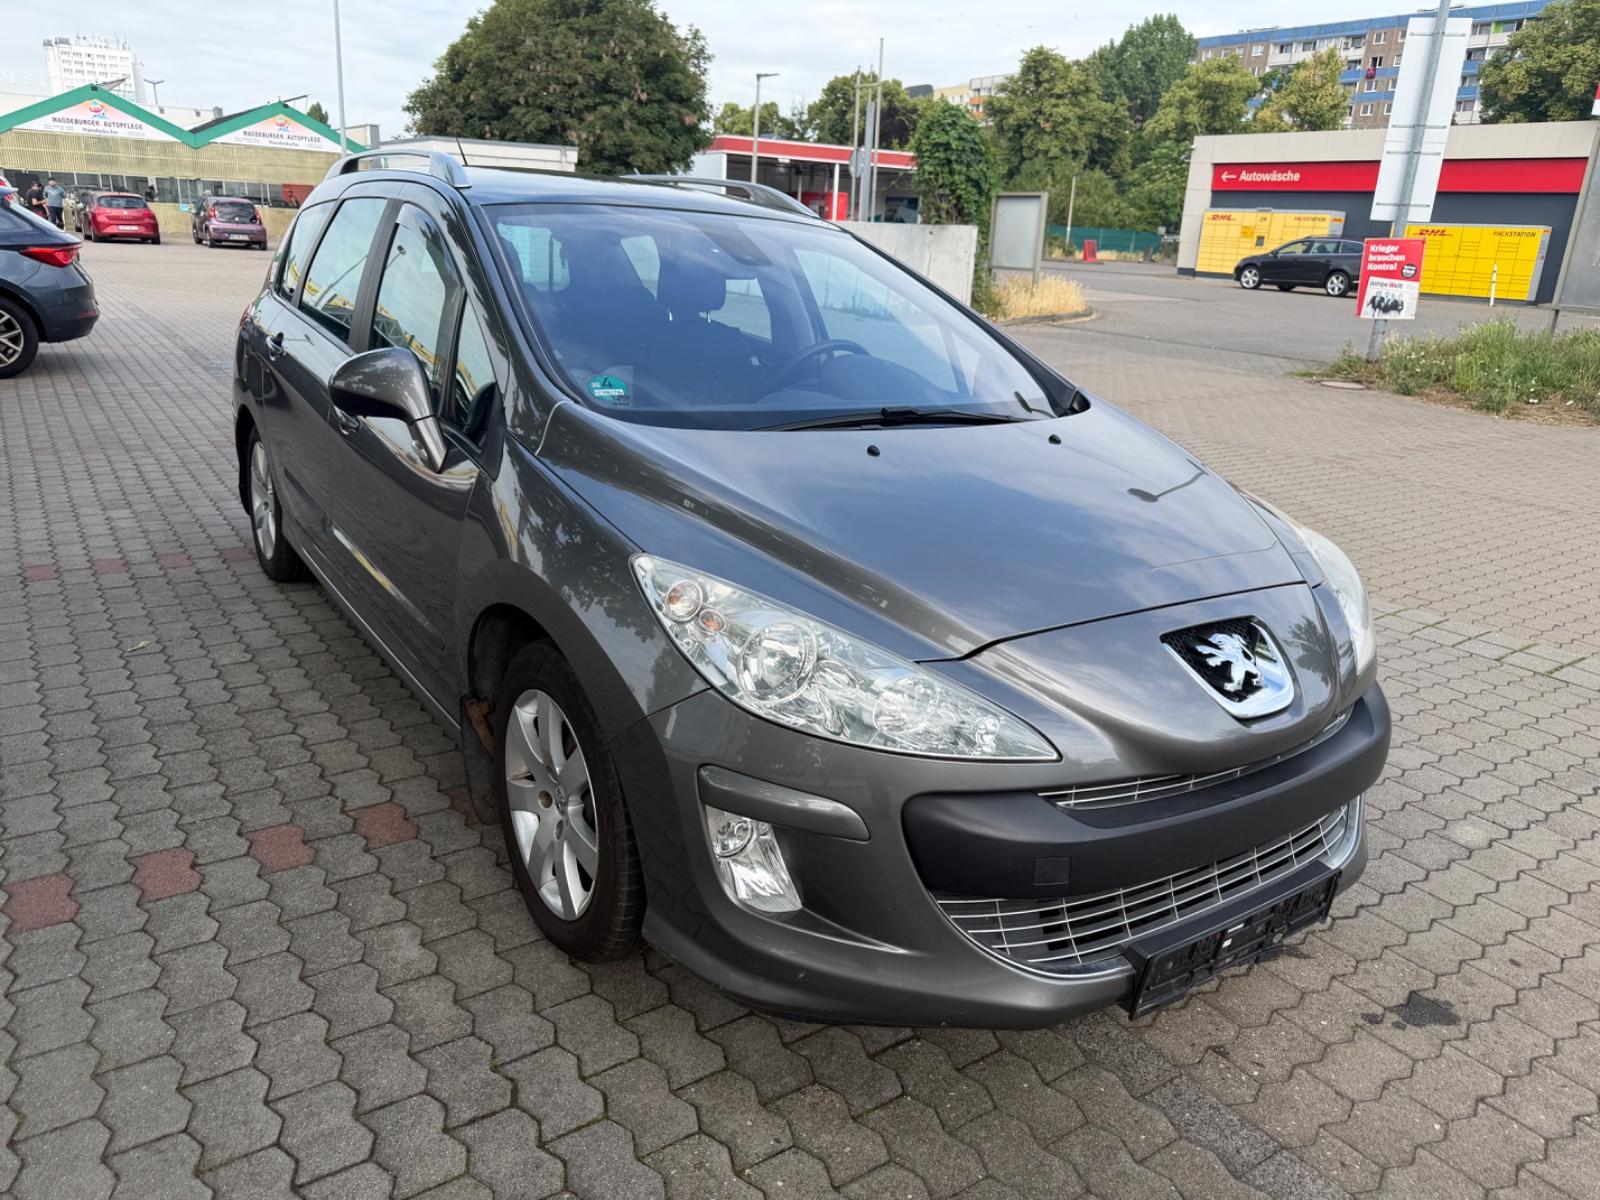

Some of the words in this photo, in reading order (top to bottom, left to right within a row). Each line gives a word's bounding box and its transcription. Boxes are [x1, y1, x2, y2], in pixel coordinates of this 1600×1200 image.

[52, 117, 100, 126] MAGDEBURGER
[103, 121, 143, 130] AUTOPFLEGE
[242, 131, 284, 140] MAGDEBURGER
[287, 134, 321, 143] AUTOPFLEGE
[1239, 170, 1301, 182] Autowäsche
[1417, 229, 1449, 237] DHL
[1369, 245, 1399, 253] Krieger
[602, 377, 613, 389] 4
